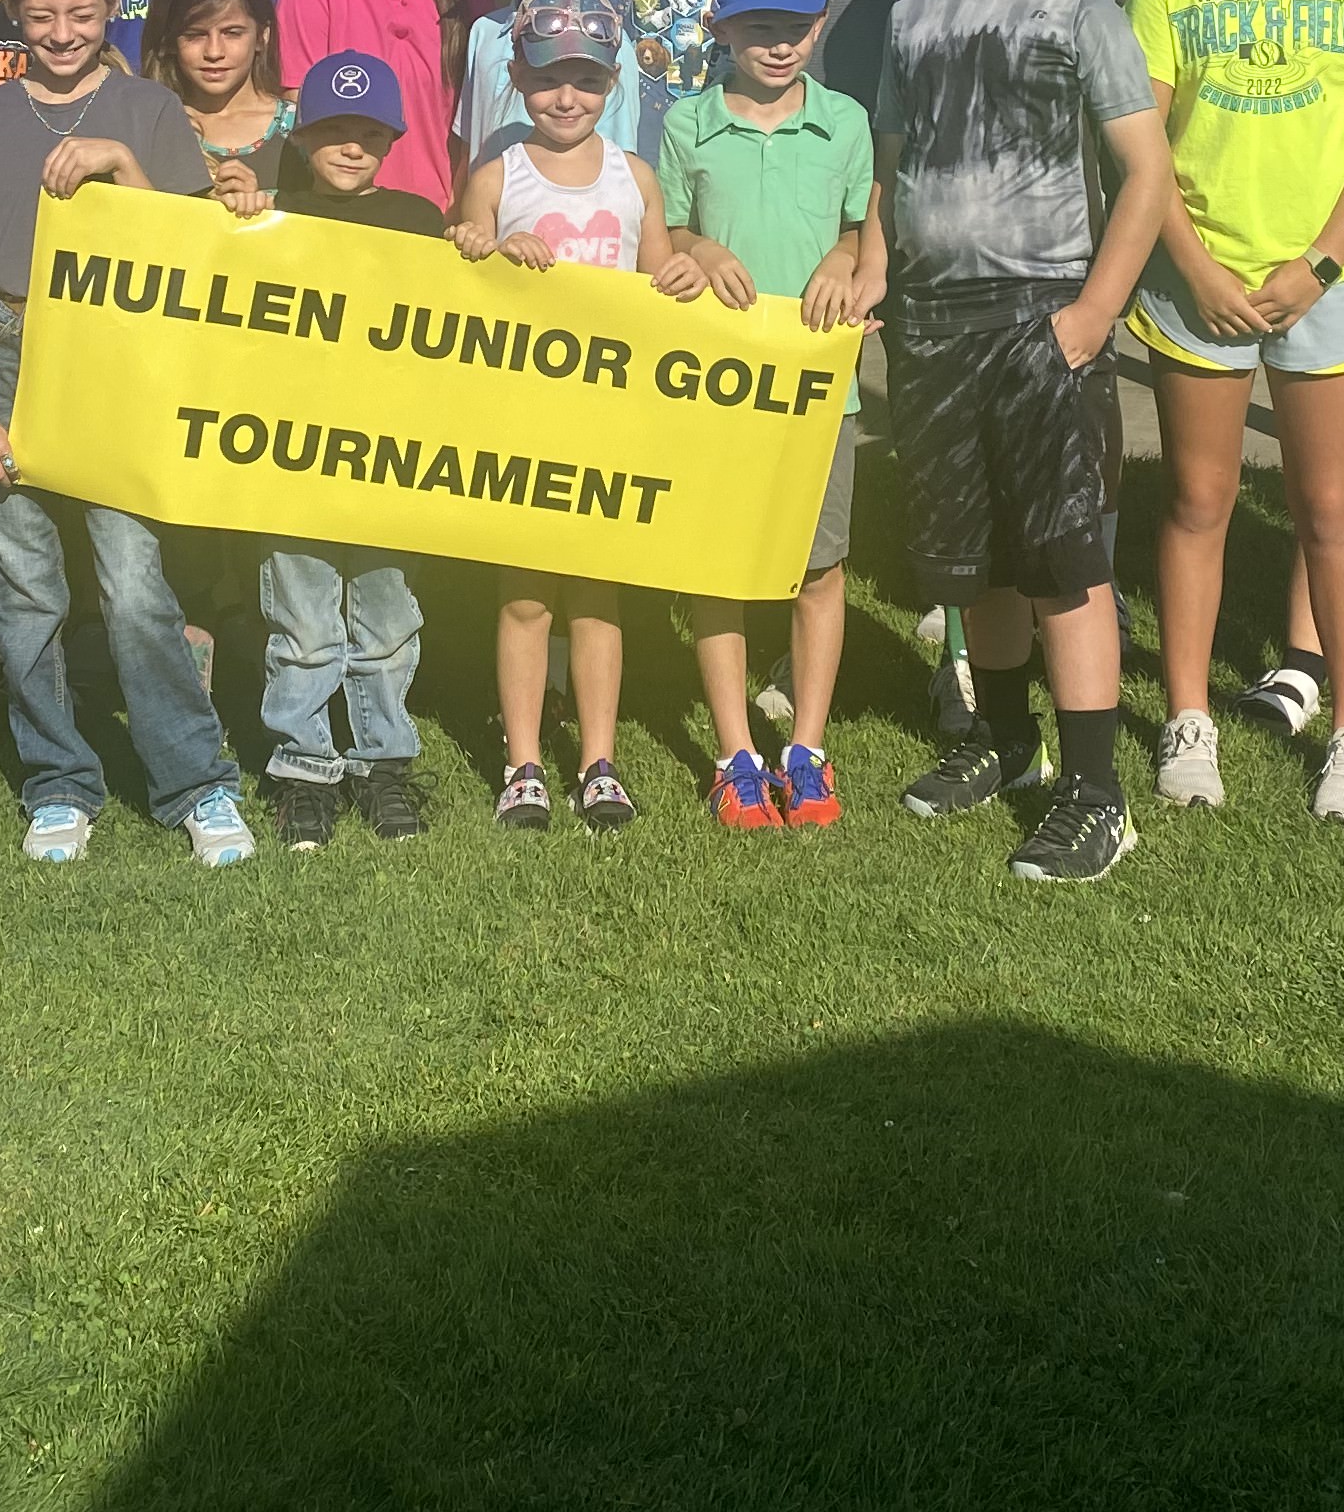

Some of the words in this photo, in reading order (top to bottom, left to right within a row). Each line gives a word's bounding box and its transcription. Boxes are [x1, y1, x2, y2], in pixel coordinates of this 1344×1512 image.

[1168, 0, 1261, 65] TRACK
[1247, 77, 1282, 96] 2022
[49, 250, 346, 342] MULLEN
[369, 304, 631, 389] JUNIOR
[656, 351, 834, 415] GOLF
[178, 408, 671, 523] TOURNAMENT
